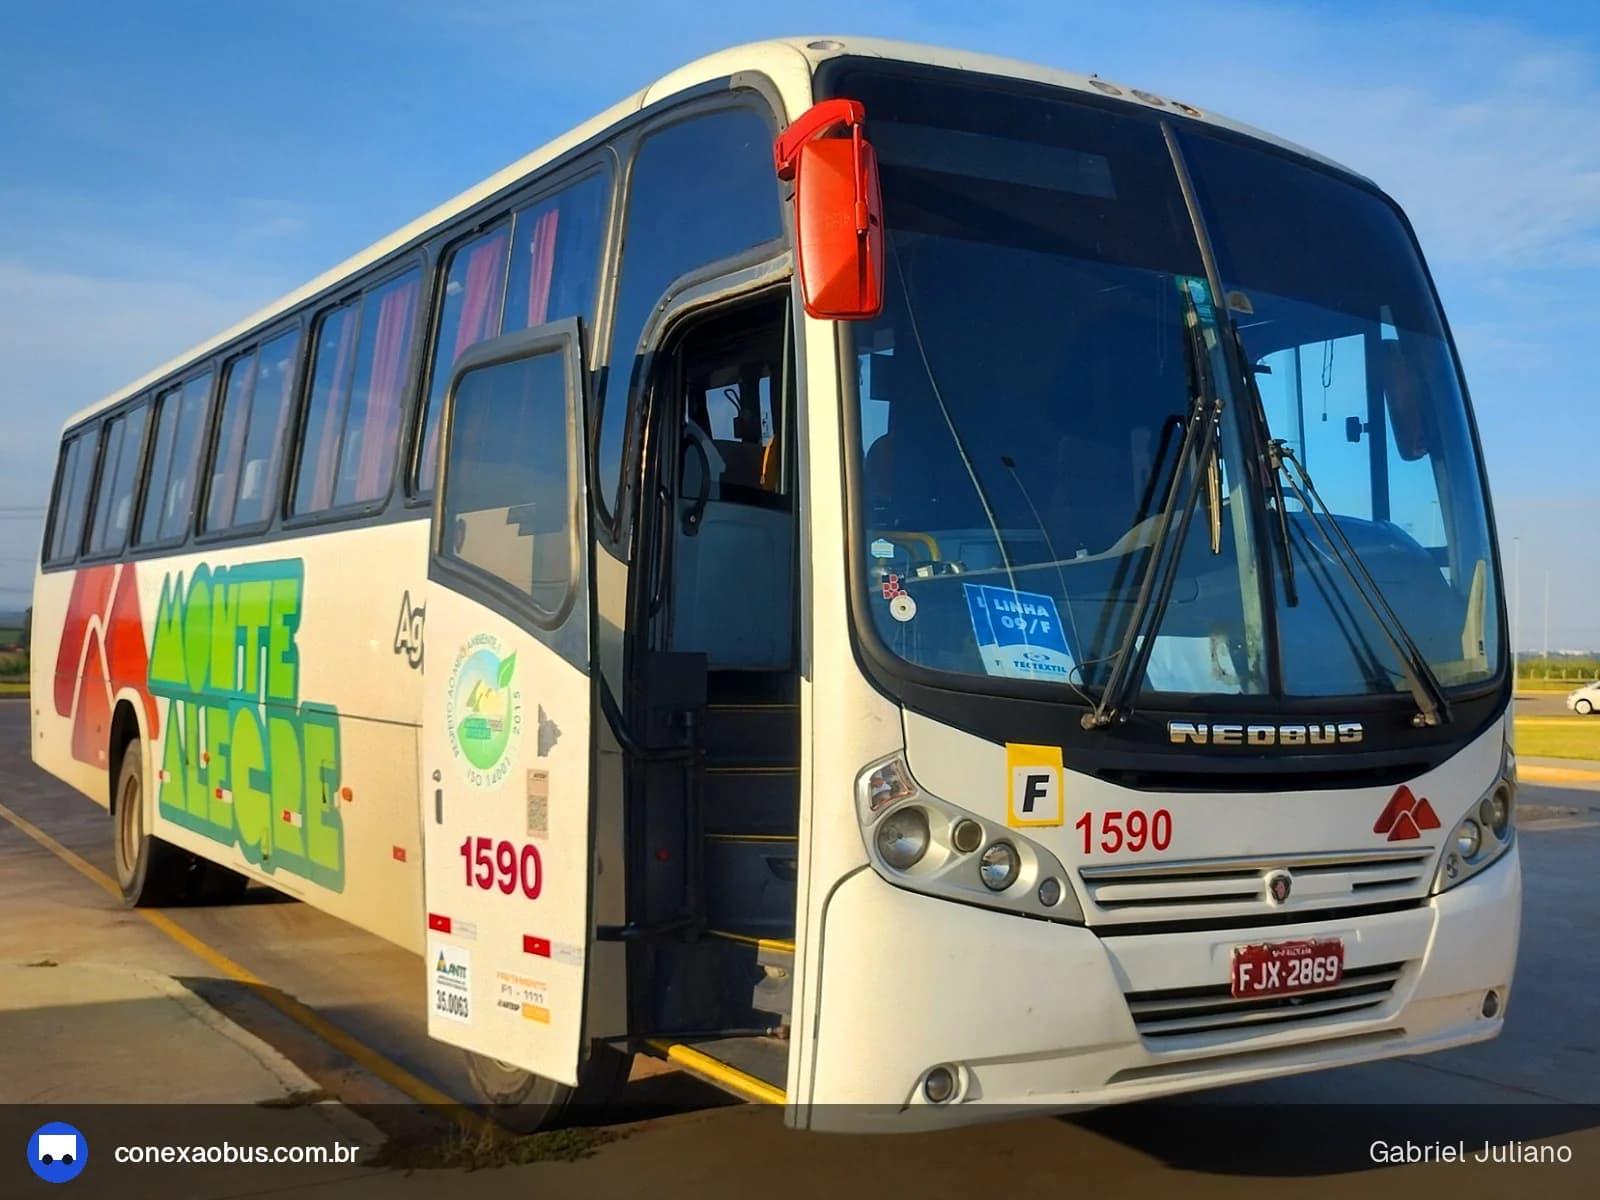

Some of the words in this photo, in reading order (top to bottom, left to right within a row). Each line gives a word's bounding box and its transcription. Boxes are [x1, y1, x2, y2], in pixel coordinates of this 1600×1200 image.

[993, 598, 1050, 617] LINHA
[1001, 615, 1051, 635] 09/F
[149, 558, 304, 703] MONTE
[394, 590, 426, 672] Ag
[1168, 721, 1363, 744] NEOBUS
[1022, 774, 1050, 813] F
[1075, 808, 1172, 854] 1590
[460, 836, 543, 900] 1590
